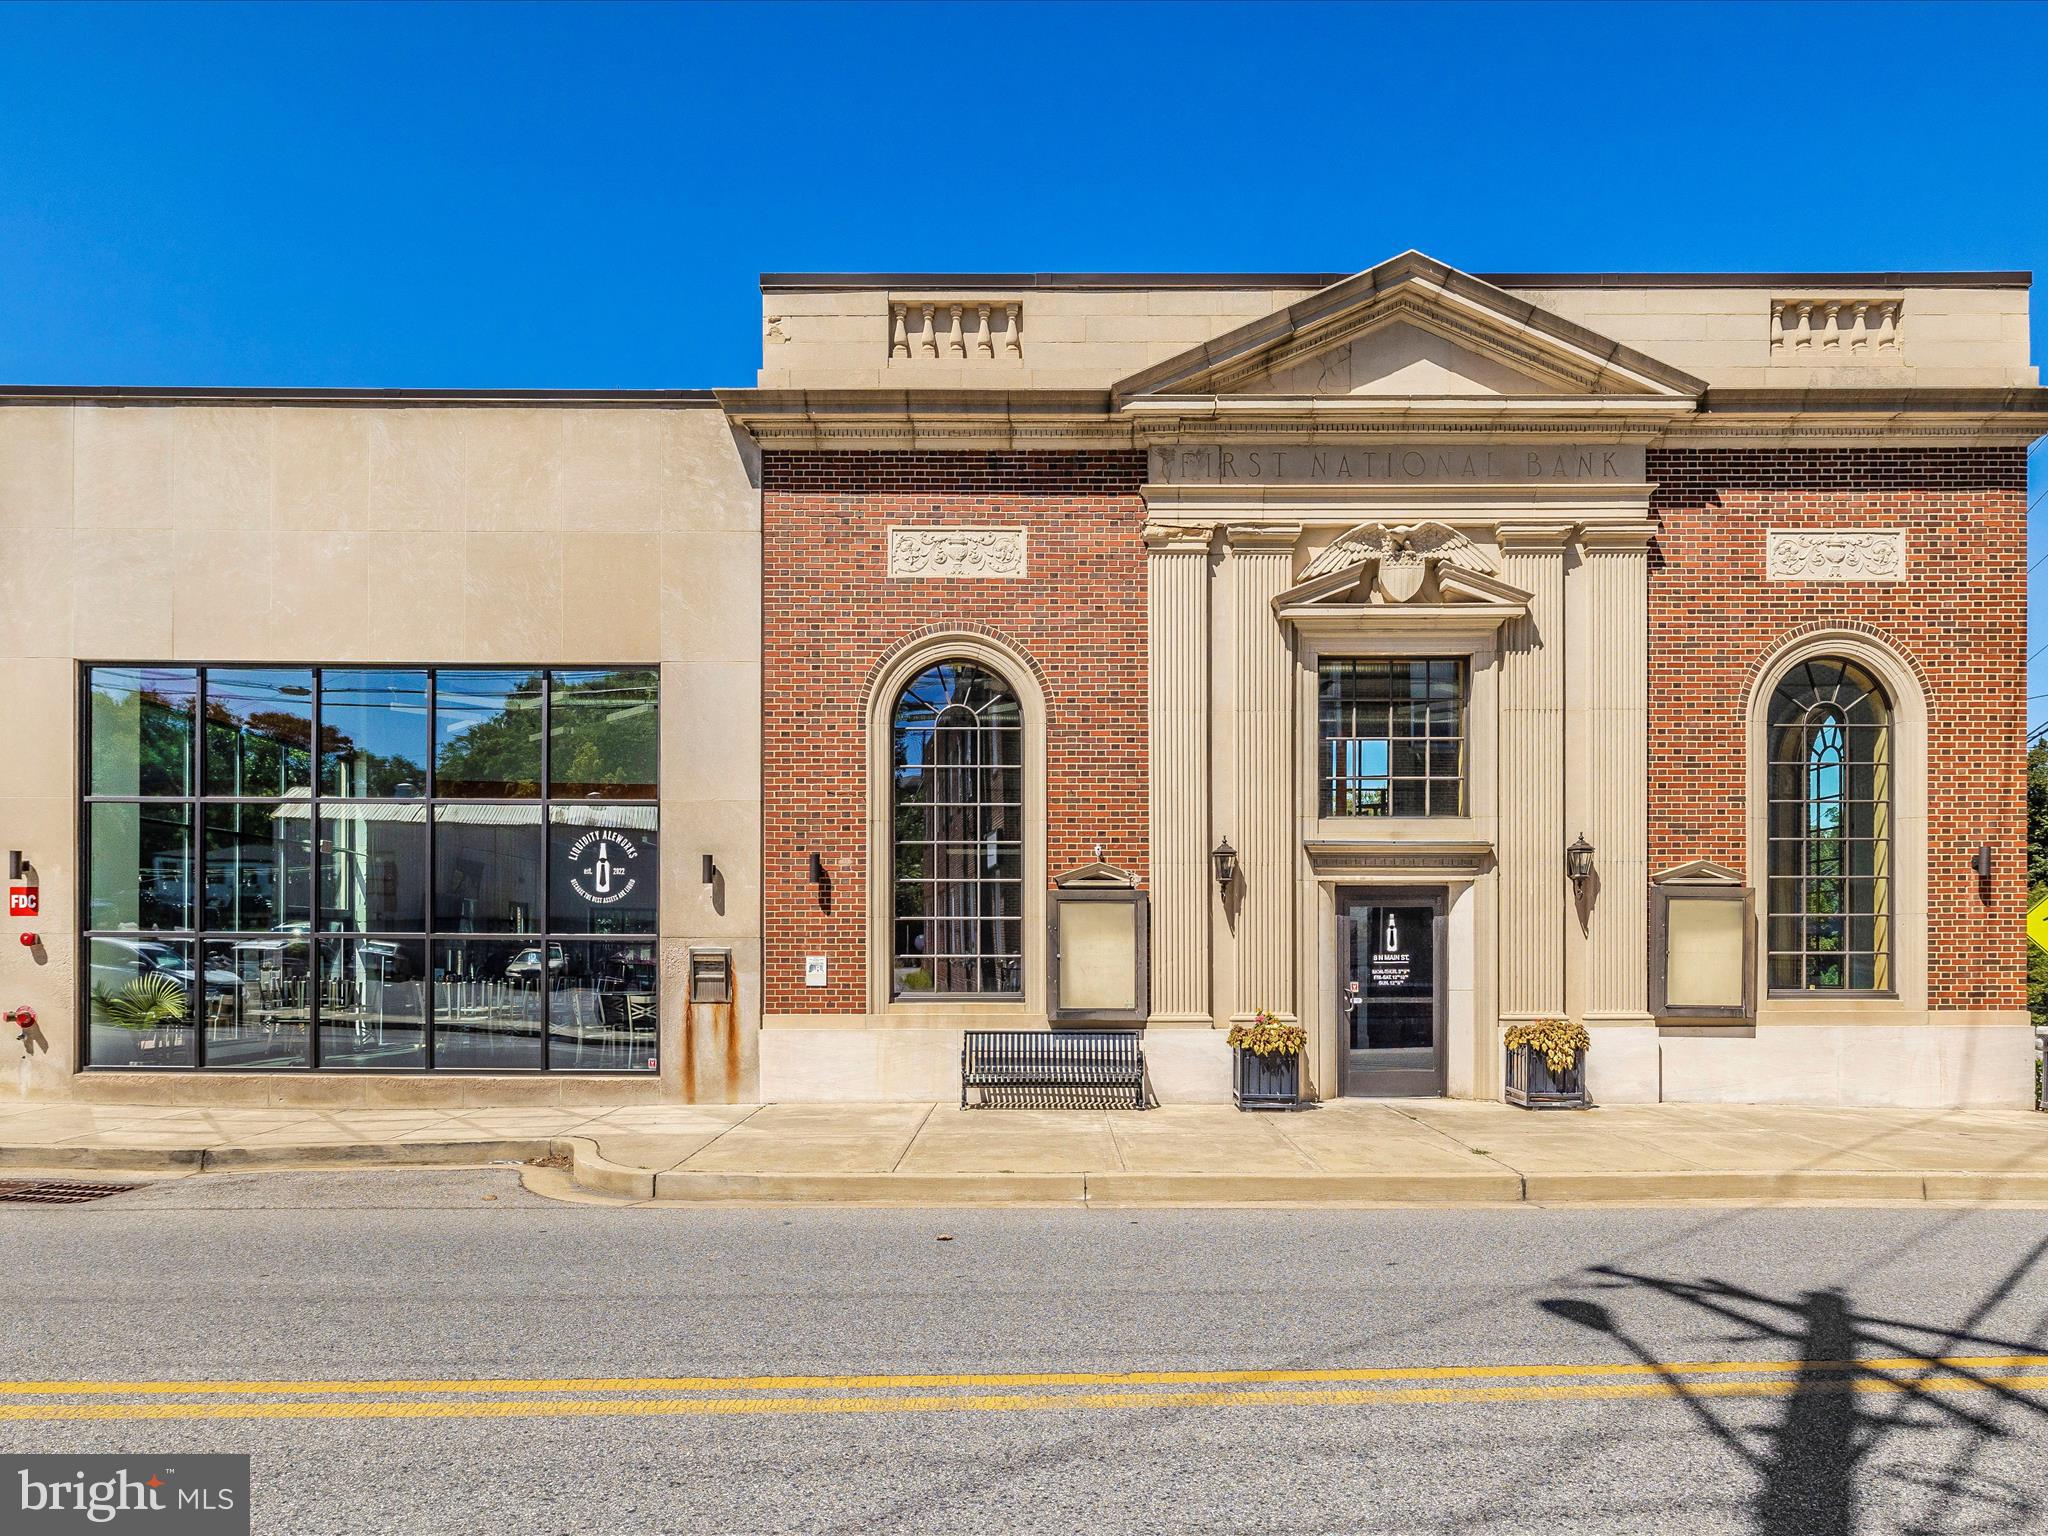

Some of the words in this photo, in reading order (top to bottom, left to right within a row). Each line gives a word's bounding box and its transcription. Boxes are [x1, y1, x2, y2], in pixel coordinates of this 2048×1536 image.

[1181, 452, 1288, 478] FIRST
[1311, 451, 1501, 478] NATIONAL
[1527, 452, 1619, 477] BANK
[568, 830, 600, 860] LIQUIDITY
[602, 830, 638, 859] ALEWORKS
[11, 894, 37, 909] FDC
